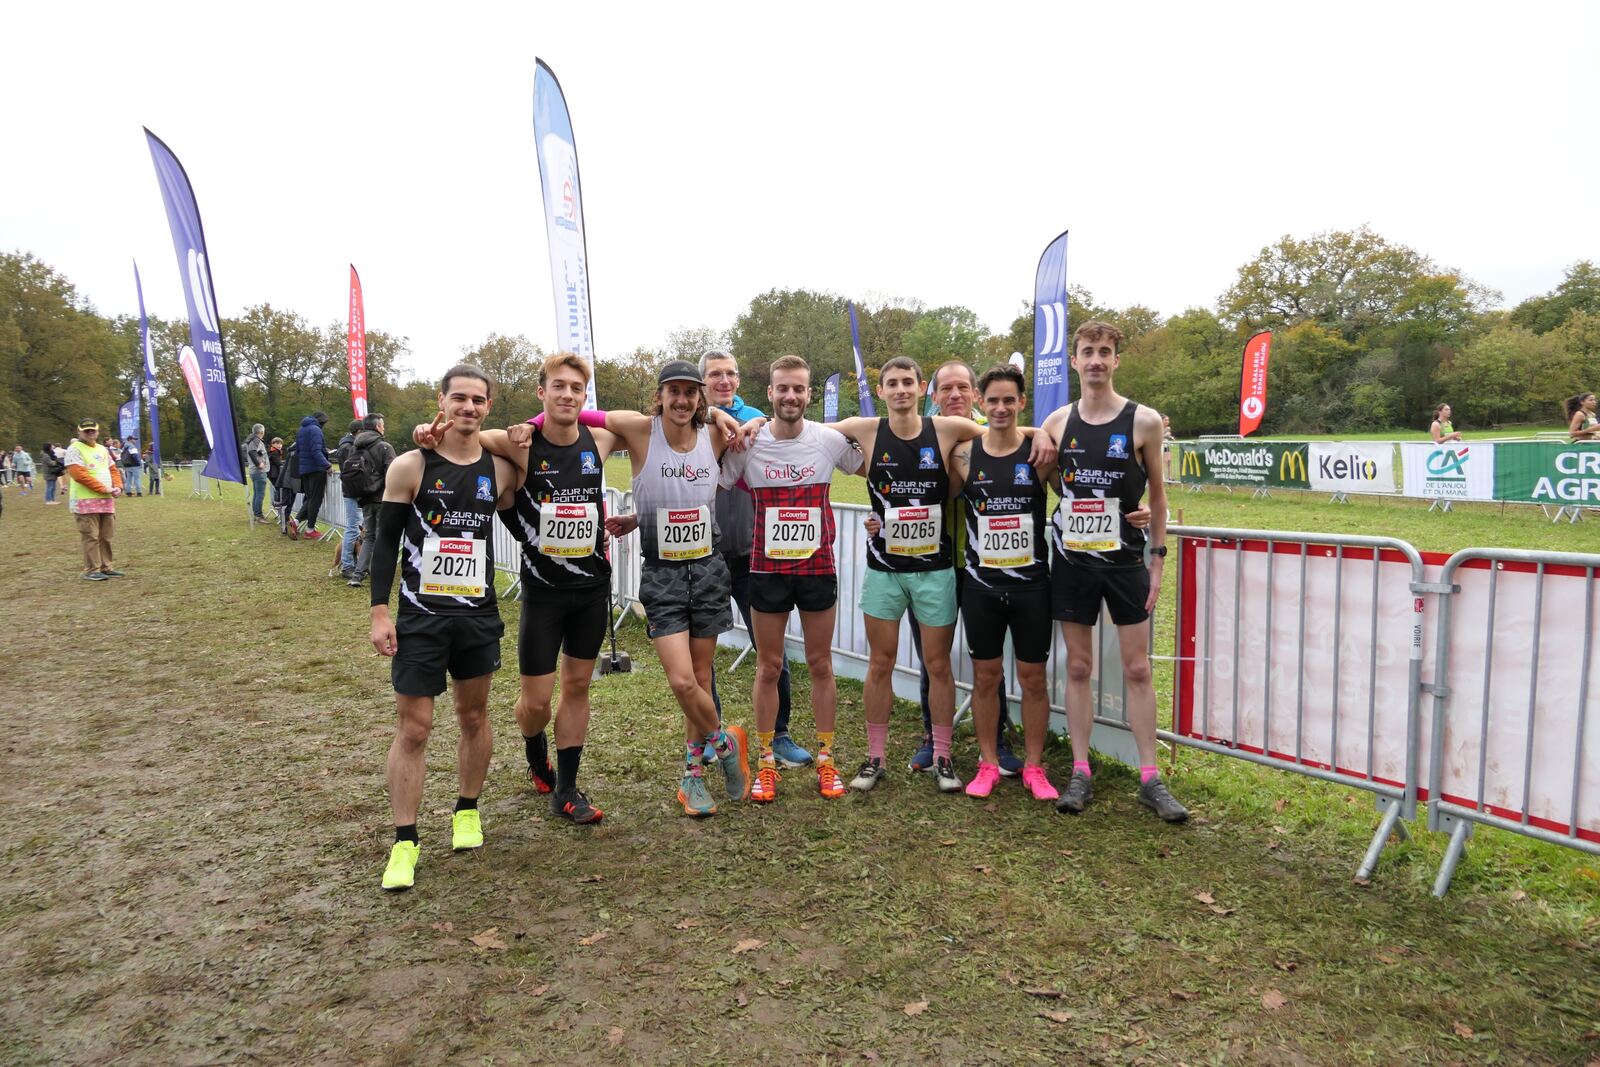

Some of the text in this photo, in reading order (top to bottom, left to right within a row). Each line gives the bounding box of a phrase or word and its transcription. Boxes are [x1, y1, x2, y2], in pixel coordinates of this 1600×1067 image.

[1038, 367, 1057, 377] PAYS
[1205, 449, 1273, 466] McDonald's
[1319, 454, 1376, 480] Kelio
[1075, 476, 1112, 485] POITOU
[443, 518, 481, 527] POITOU
[444, 511, 491, 522] AZUR NET
[1068, 515, 1112, 533] 20272
[547, 520, 592, 539] 20269
[664, 522, 706, 543] 20267
[773, 524, 815, 541] 20270
[892, 522, 935, 539] 20265
[984, 531, 1028, 550] 20266
[432, 556, 476, 577] 20271
